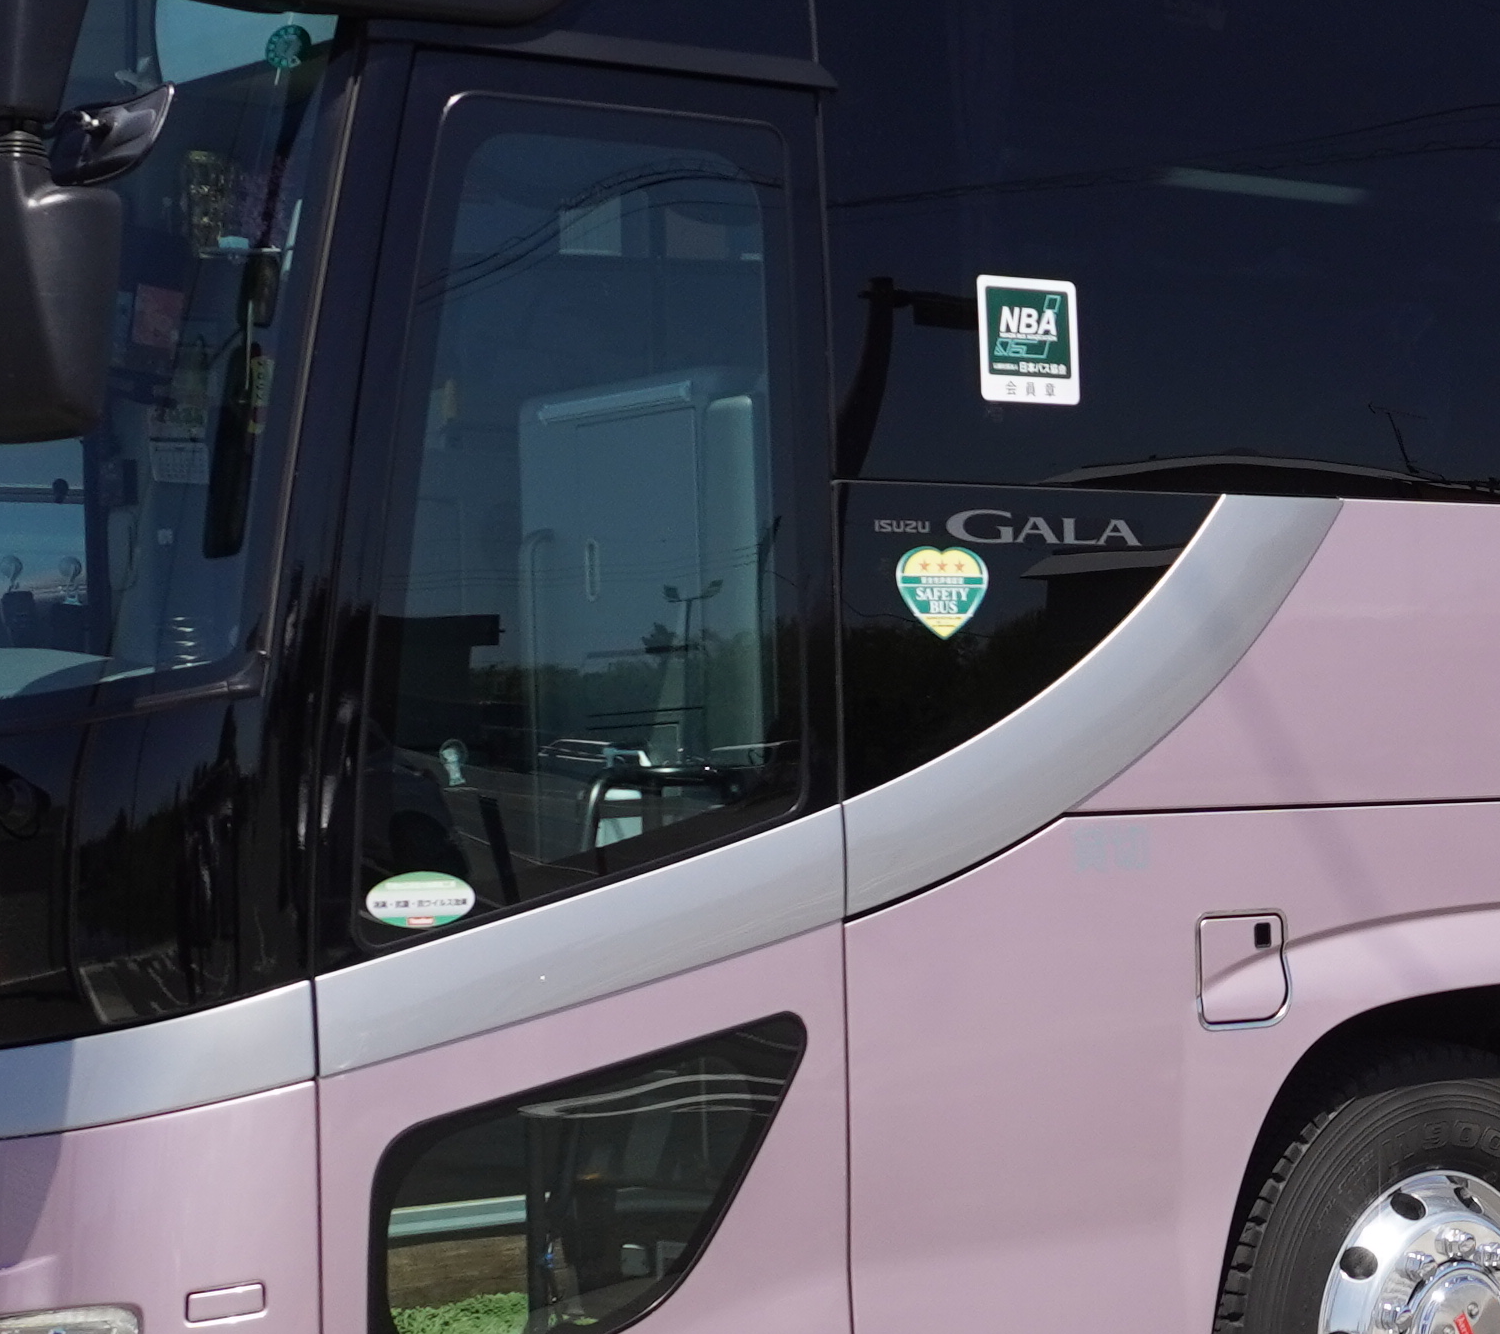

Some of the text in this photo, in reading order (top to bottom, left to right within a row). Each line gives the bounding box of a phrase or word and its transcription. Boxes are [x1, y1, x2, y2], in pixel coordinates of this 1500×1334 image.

[999, 305, 1059, 336] NBA
[874, 518, 931, 534] ISUZU
[915, 587, 970, 602] SAFETY
[929, 600, 960, 614] BUS
